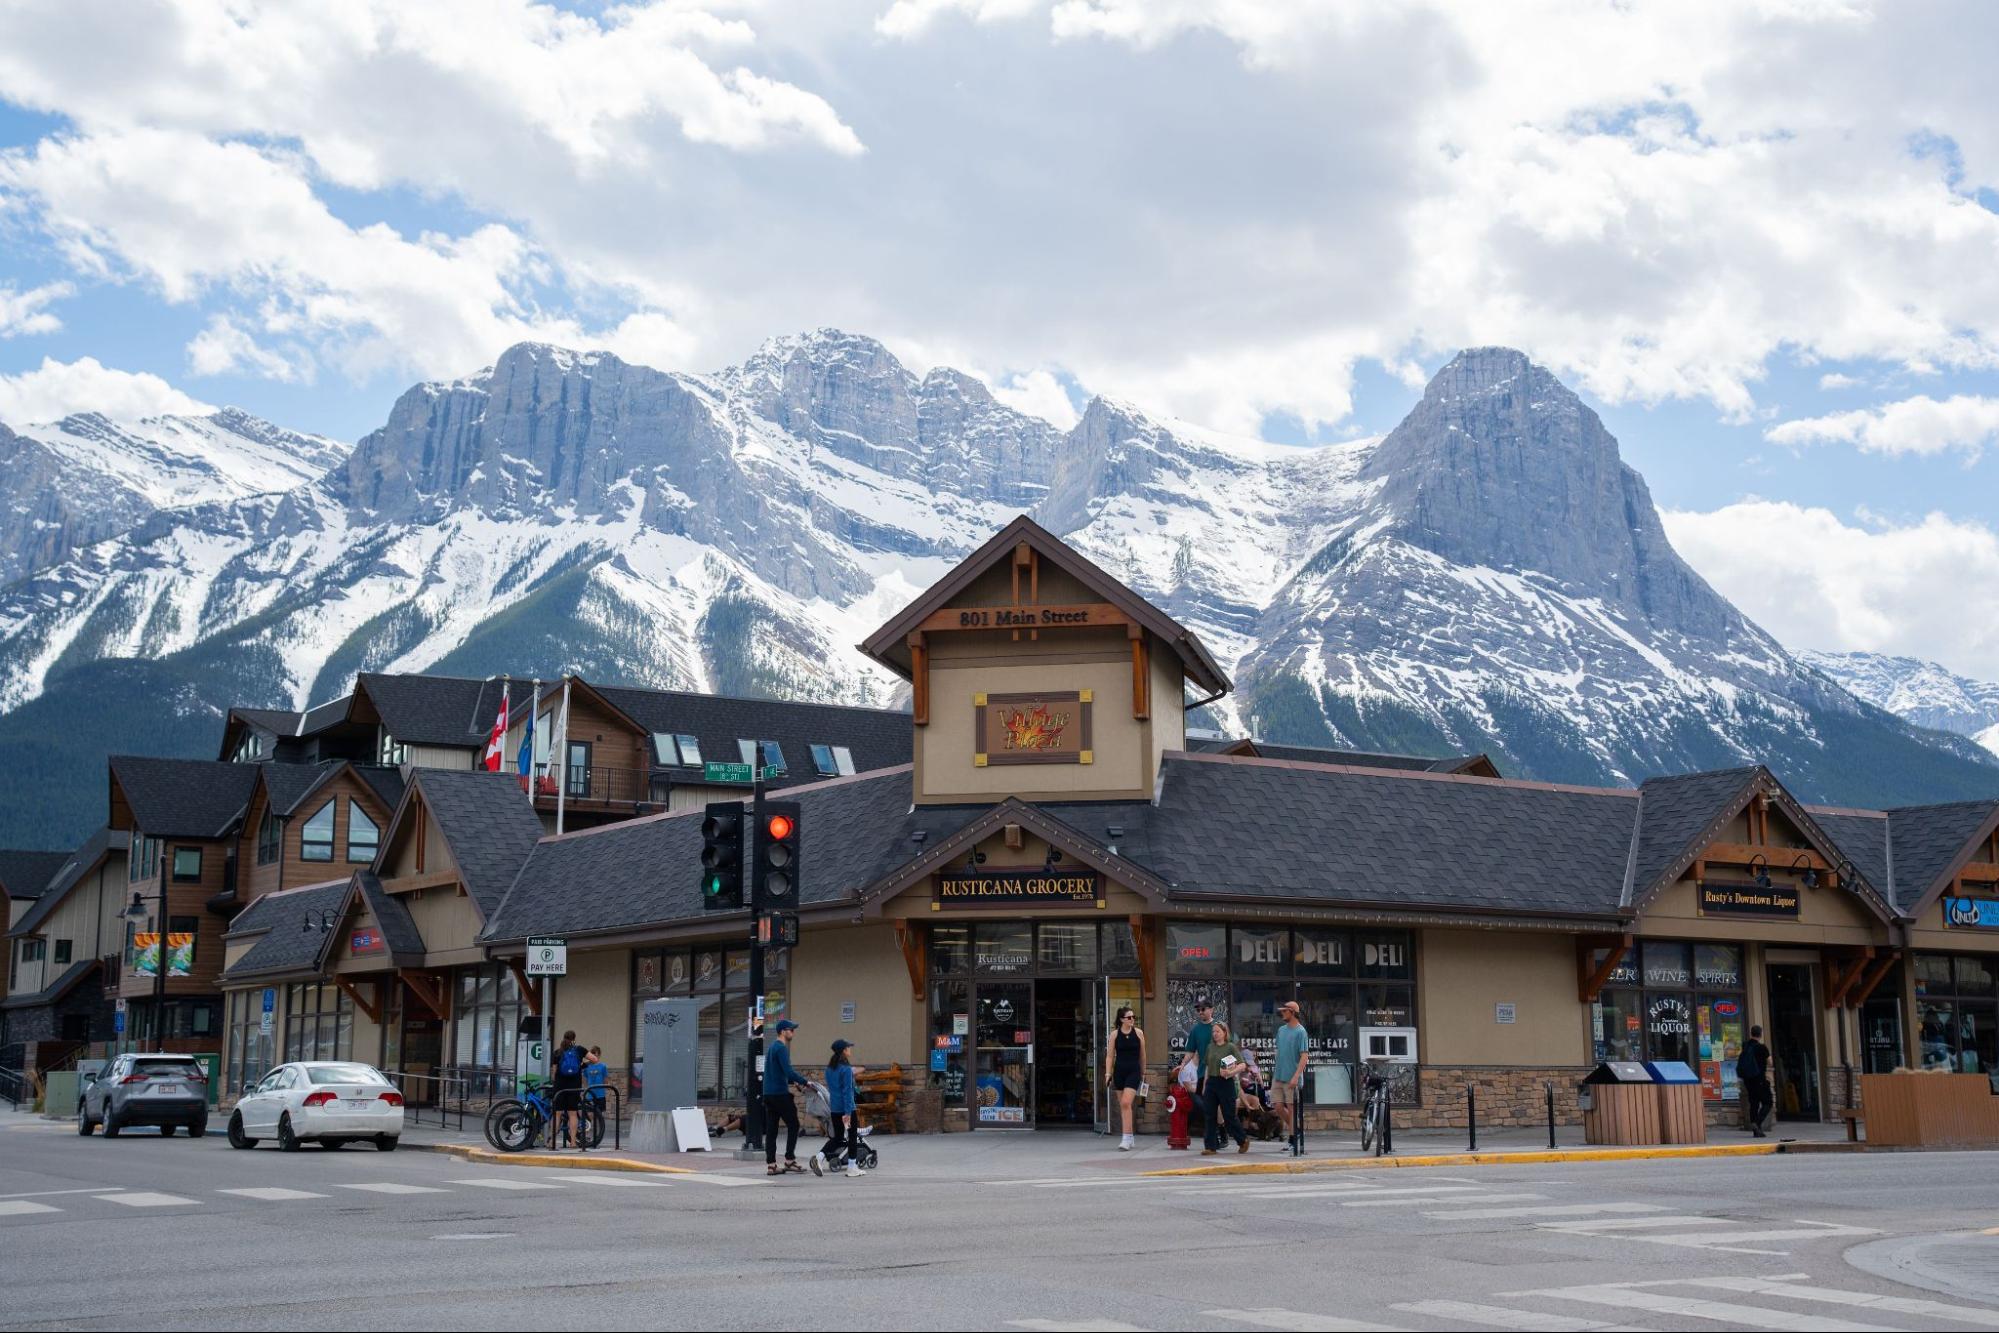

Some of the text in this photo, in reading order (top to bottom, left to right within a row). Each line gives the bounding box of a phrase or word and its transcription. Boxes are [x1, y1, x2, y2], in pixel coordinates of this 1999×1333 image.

[960, 609, 1088, 626] 801 Main Street
[998, 706, 1070, 734] Village
[710, 764, 749, 773] MAIN STREET
[942, 878, 1094, 896] RUSTICANA GROCERY
[1705, 891, 1796, 908] Rusty's Downtown Liquor
[977, 953, 1028, 963] Rusticana
[1182, 947, 1209, 958] OPEN
[1241, 940, 1281, 963] DELI
[1303, 941, 1342, 964] DELI
[1365, 943, 1403, 966] DELI
[1648, 970, 1687, 982] WINE
[1700, 972, 1738, 984] SPIRITS
[1649, 998, 1690, 1018] RUSTY'S
[1716, 1004, 1737, 1012] OPEN
[1650, 1022, 1690, 1035] LIQUOR
[938, 1036, 960, 1046] M&M
[1241, 1038, 1348, 1048] ESPRESS ELI EATS
